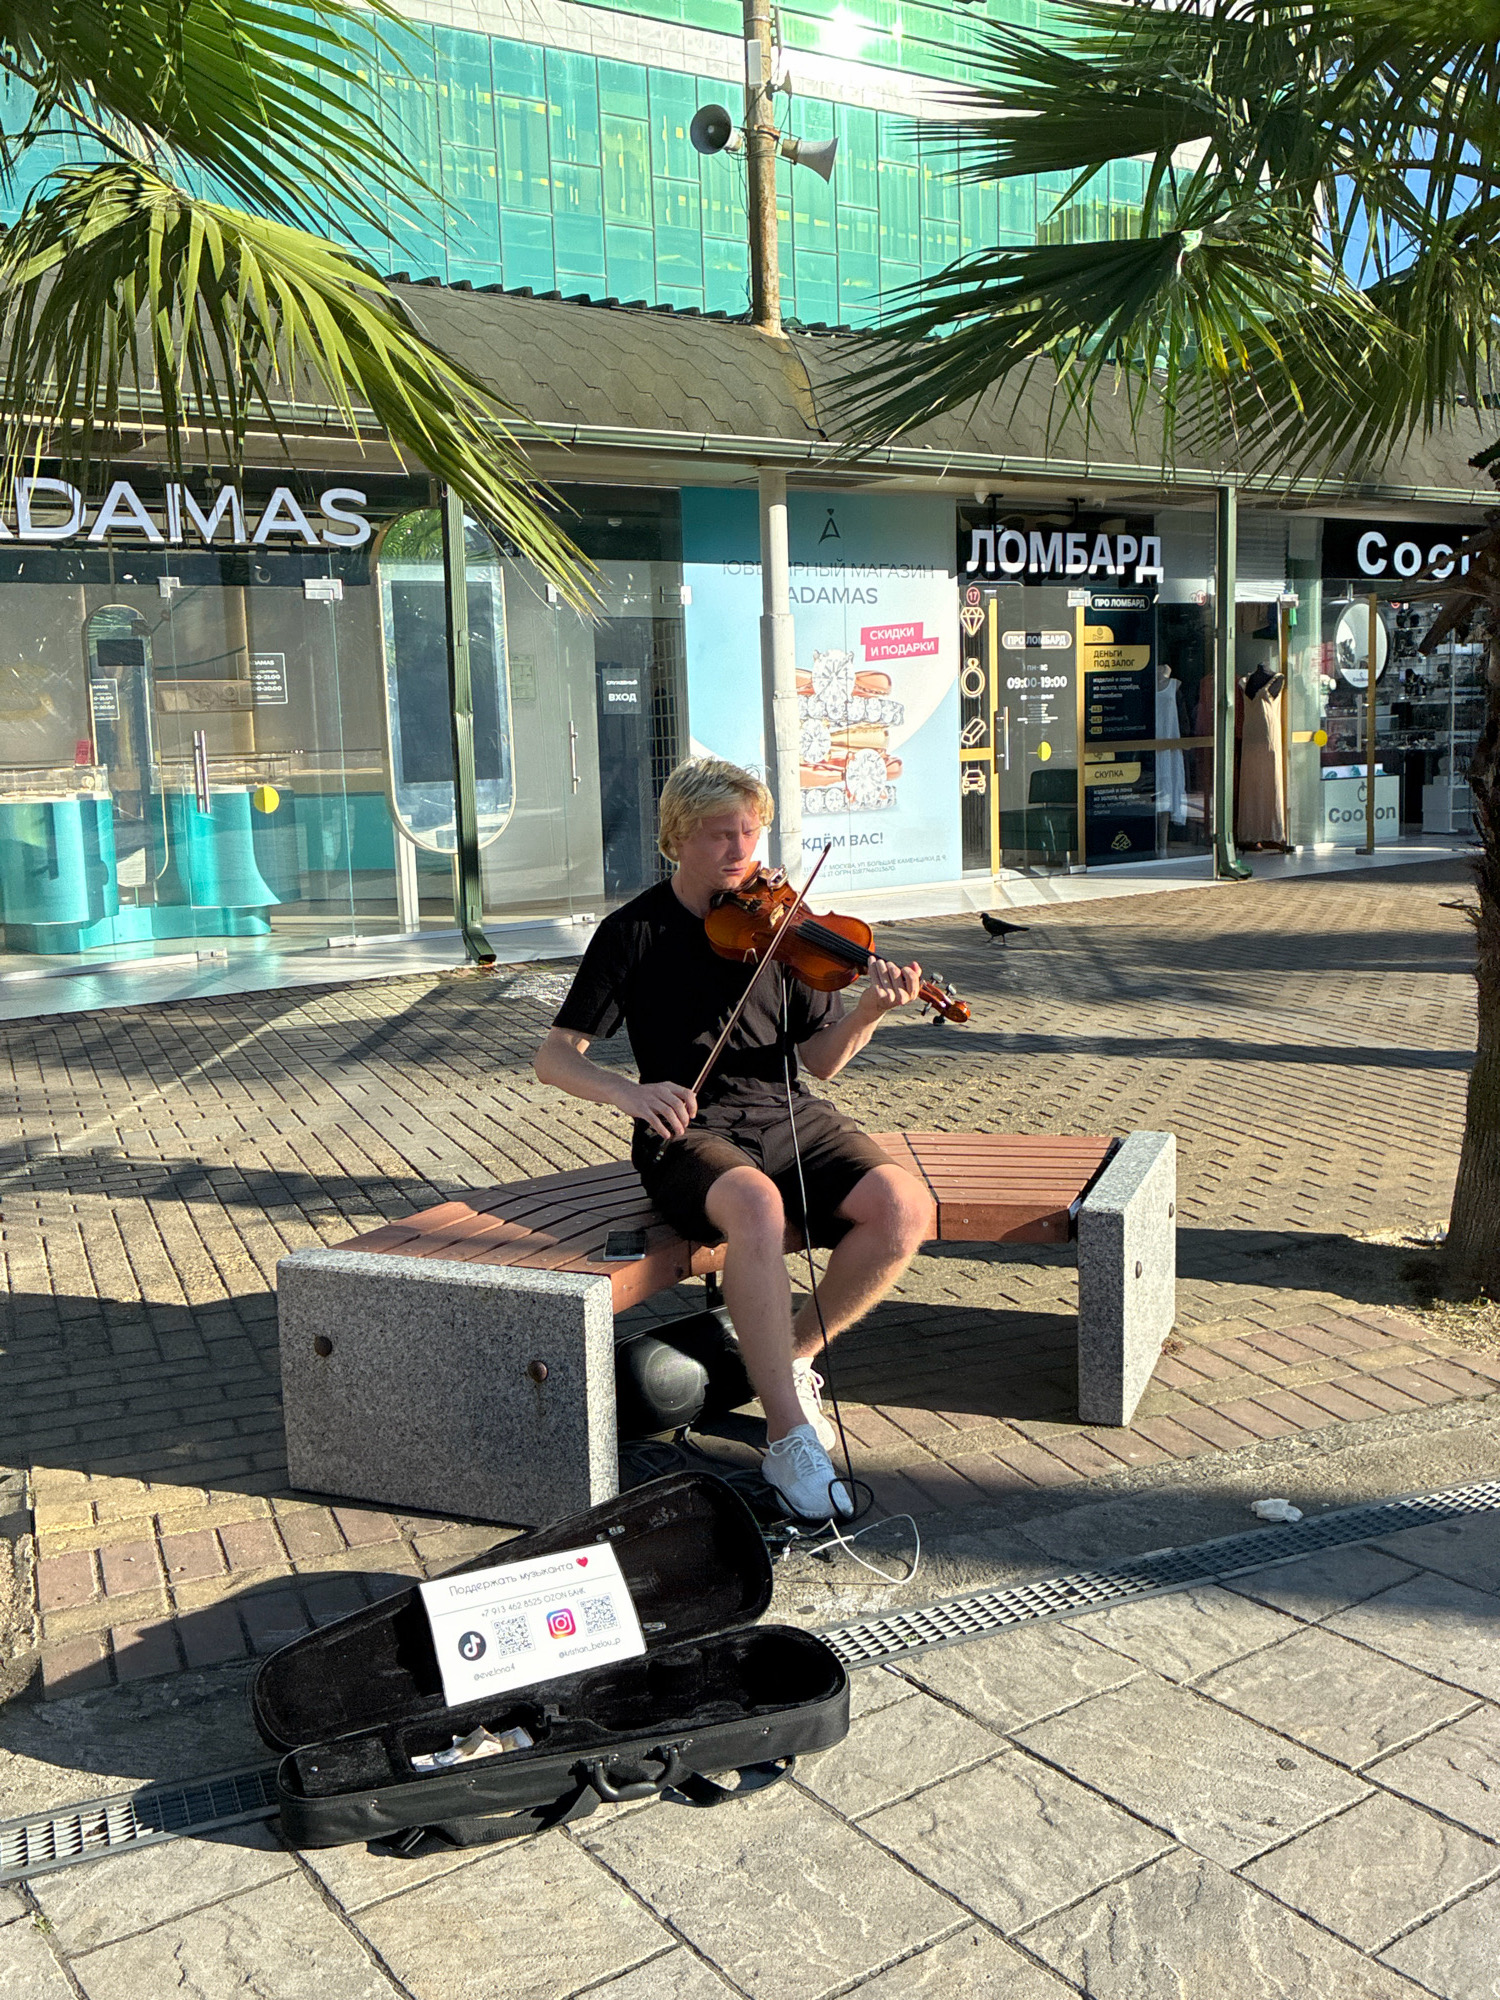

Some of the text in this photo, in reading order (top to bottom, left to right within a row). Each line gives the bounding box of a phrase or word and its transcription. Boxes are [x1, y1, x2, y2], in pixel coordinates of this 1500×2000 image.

[0, 476, 372, 547] DAMAS
[966, 529, 1164, 583] ЛОМБАРД
[722, 558, 934, 579] ЮВЕРНЫЙ МАГАЗИН
[1094, 598, 1146, 608] ПРО ЛОМБАРД
[869, 627, 915, 640] СКИДКИ
[1007, 634, 1067, 646] ПРО ЛОМБАРД
[870, 641, 935, 657] И ПОДАРКИ
[1093, 650, 1123, 659] ДЕНЬГИ
[1093, 658, 1135, 668] ПОД ЗАЛОГ
[608, 693, 637, 703] ВХОД
[1094, 769, 1124, 779] СКУПКА
[1328, 803, 1396, 823] Cooon
[849, 832, 884, 847] ВАС!
[448, 1562, 574, 1597] Поддержать музыканта
[481, 1587, 587, 1617] +7 913 462 8525 OZON БАНК
